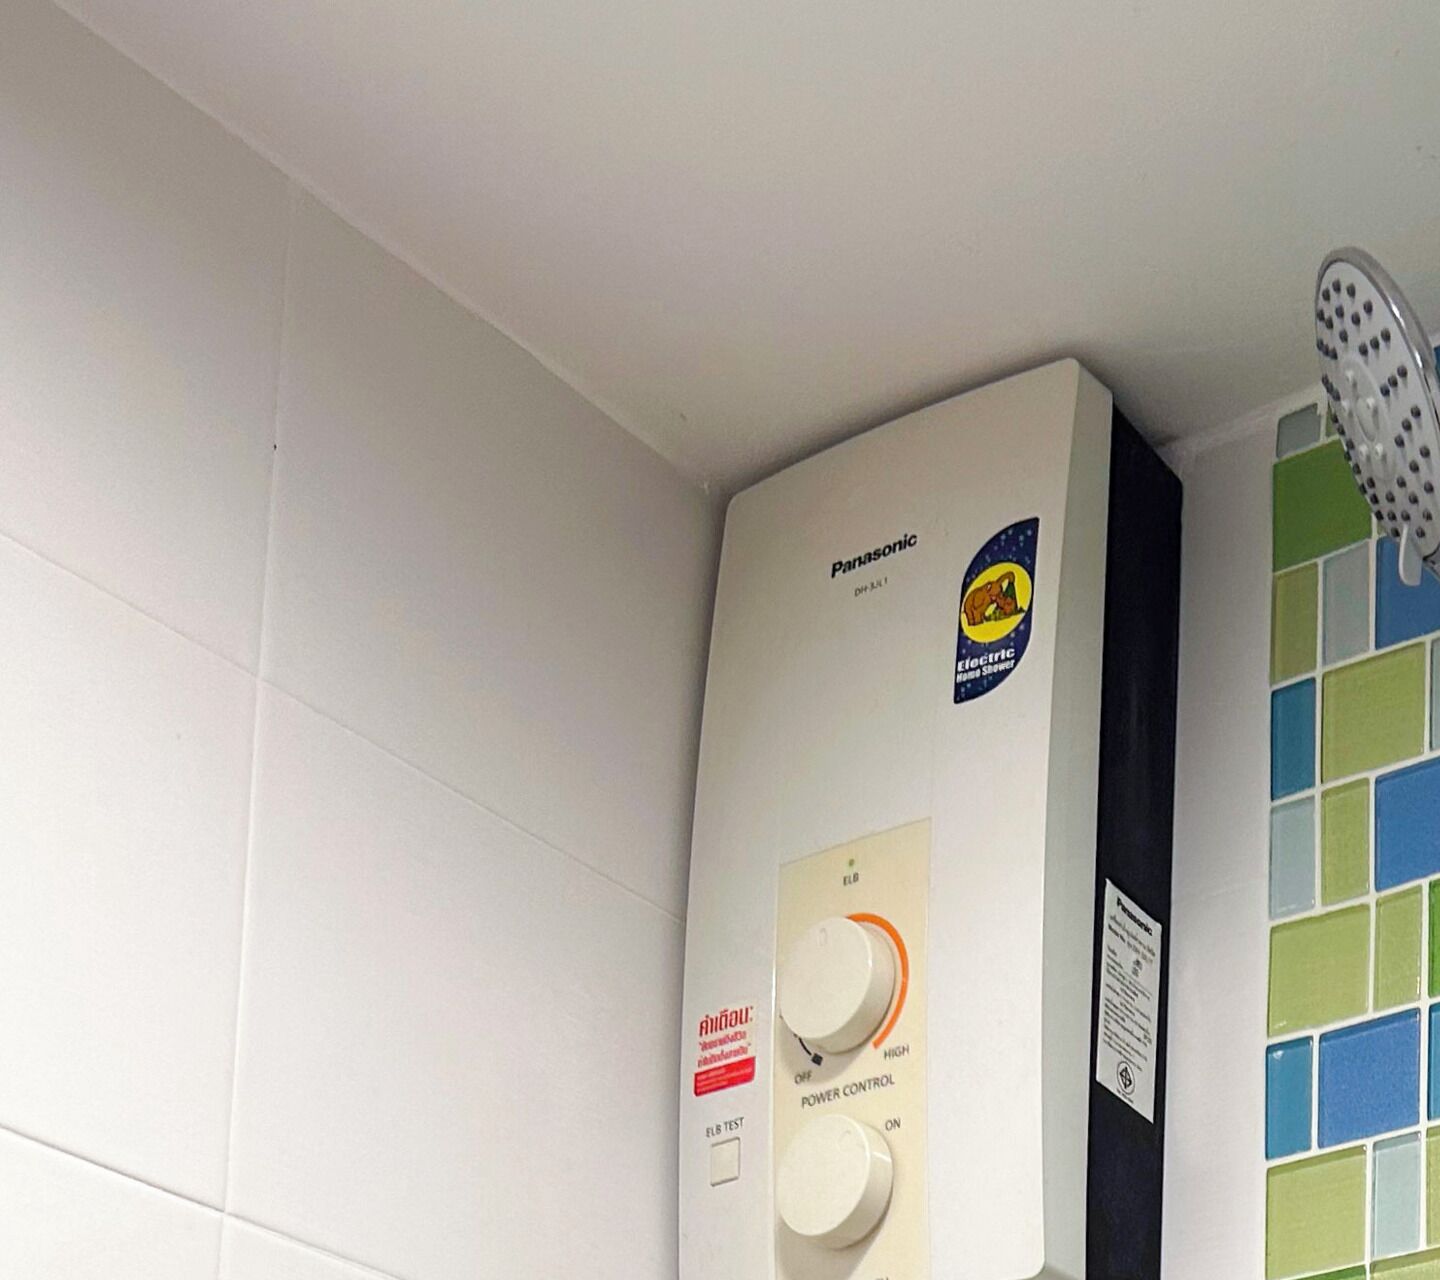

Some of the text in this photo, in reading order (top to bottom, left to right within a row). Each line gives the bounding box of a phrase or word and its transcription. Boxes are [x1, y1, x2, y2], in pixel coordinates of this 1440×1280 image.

[831, 533, 918, 579] Panasonic
[957, 648, 1015, 672] Electric
[982, 659, 1015, 676] Shower
[1116, 895, 1153, 937] Panasonic
[883, 1044, 910, 1061] HIGH
[794, 1070, 812, 1085] OFF
[801, 1073, 895, 1109] POWER CONTROL
[706, 1116, 744, 1138] ELB TEST
[885, 1118, 902, 1131] ON
